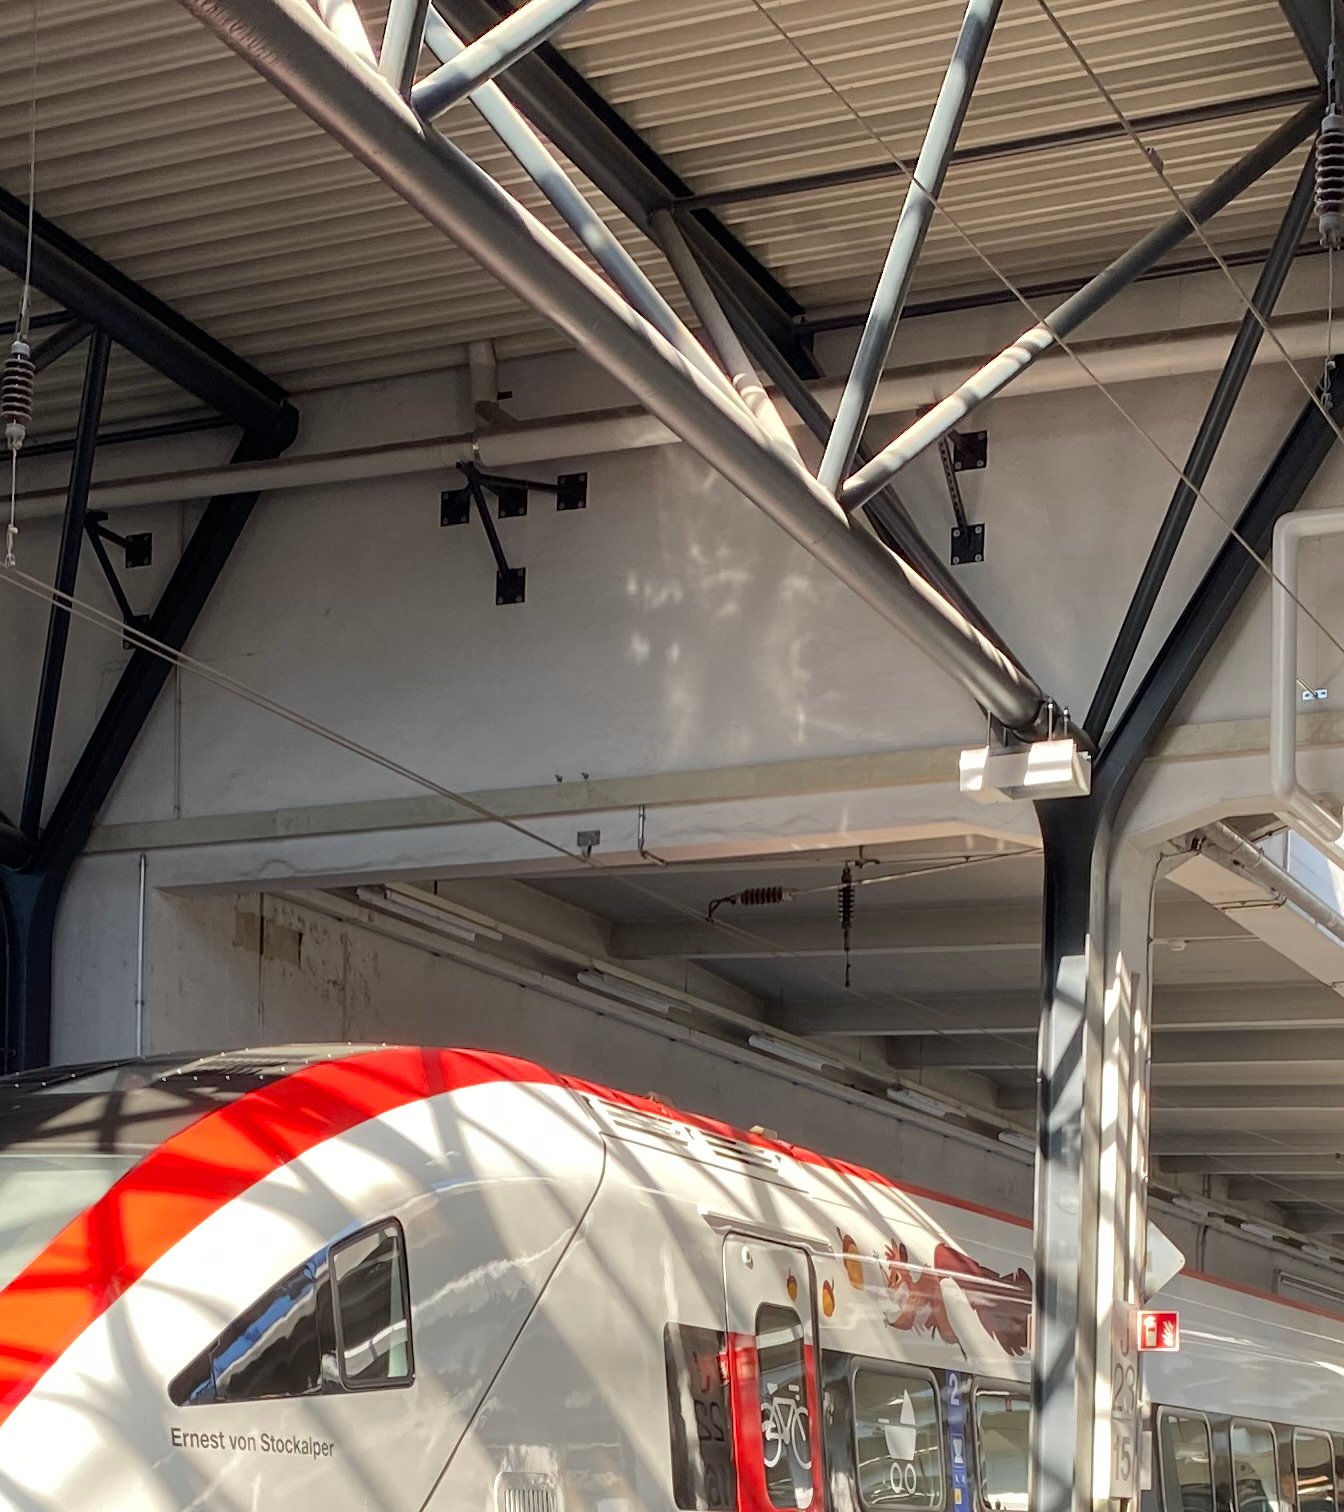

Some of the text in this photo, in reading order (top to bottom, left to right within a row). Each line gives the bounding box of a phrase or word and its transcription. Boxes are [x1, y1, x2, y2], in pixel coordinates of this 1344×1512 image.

[1119, 1309, 1131, 1357] J
[949, 1373, 960, 1407] 2
[1112, 1363, 1136, 1414] 23
[170, 1427, 335, 1460] Ernest von Stockalper
[1115, 1435, 1132, 1482] 15
